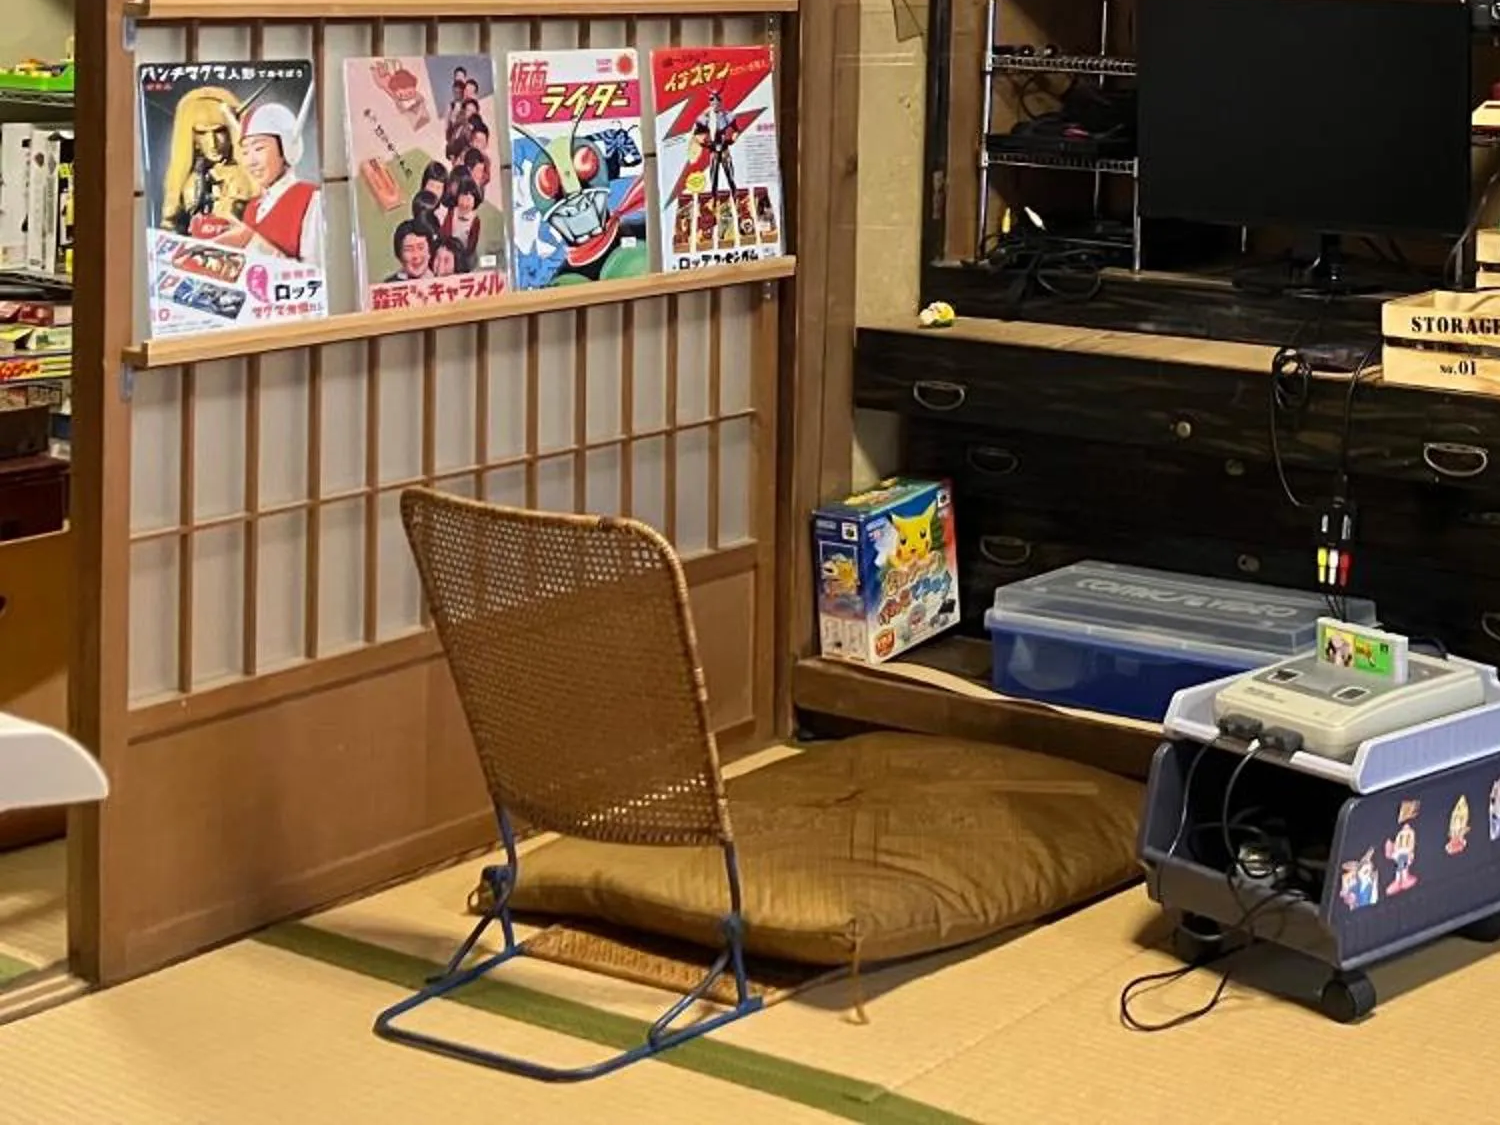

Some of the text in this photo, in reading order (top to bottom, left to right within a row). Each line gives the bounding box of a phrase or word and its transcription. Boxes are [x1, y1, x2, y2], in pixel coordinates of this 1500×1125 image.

[540, 81, 631, 121] ライダー
[275, 280, 323, 302] ロッテ
